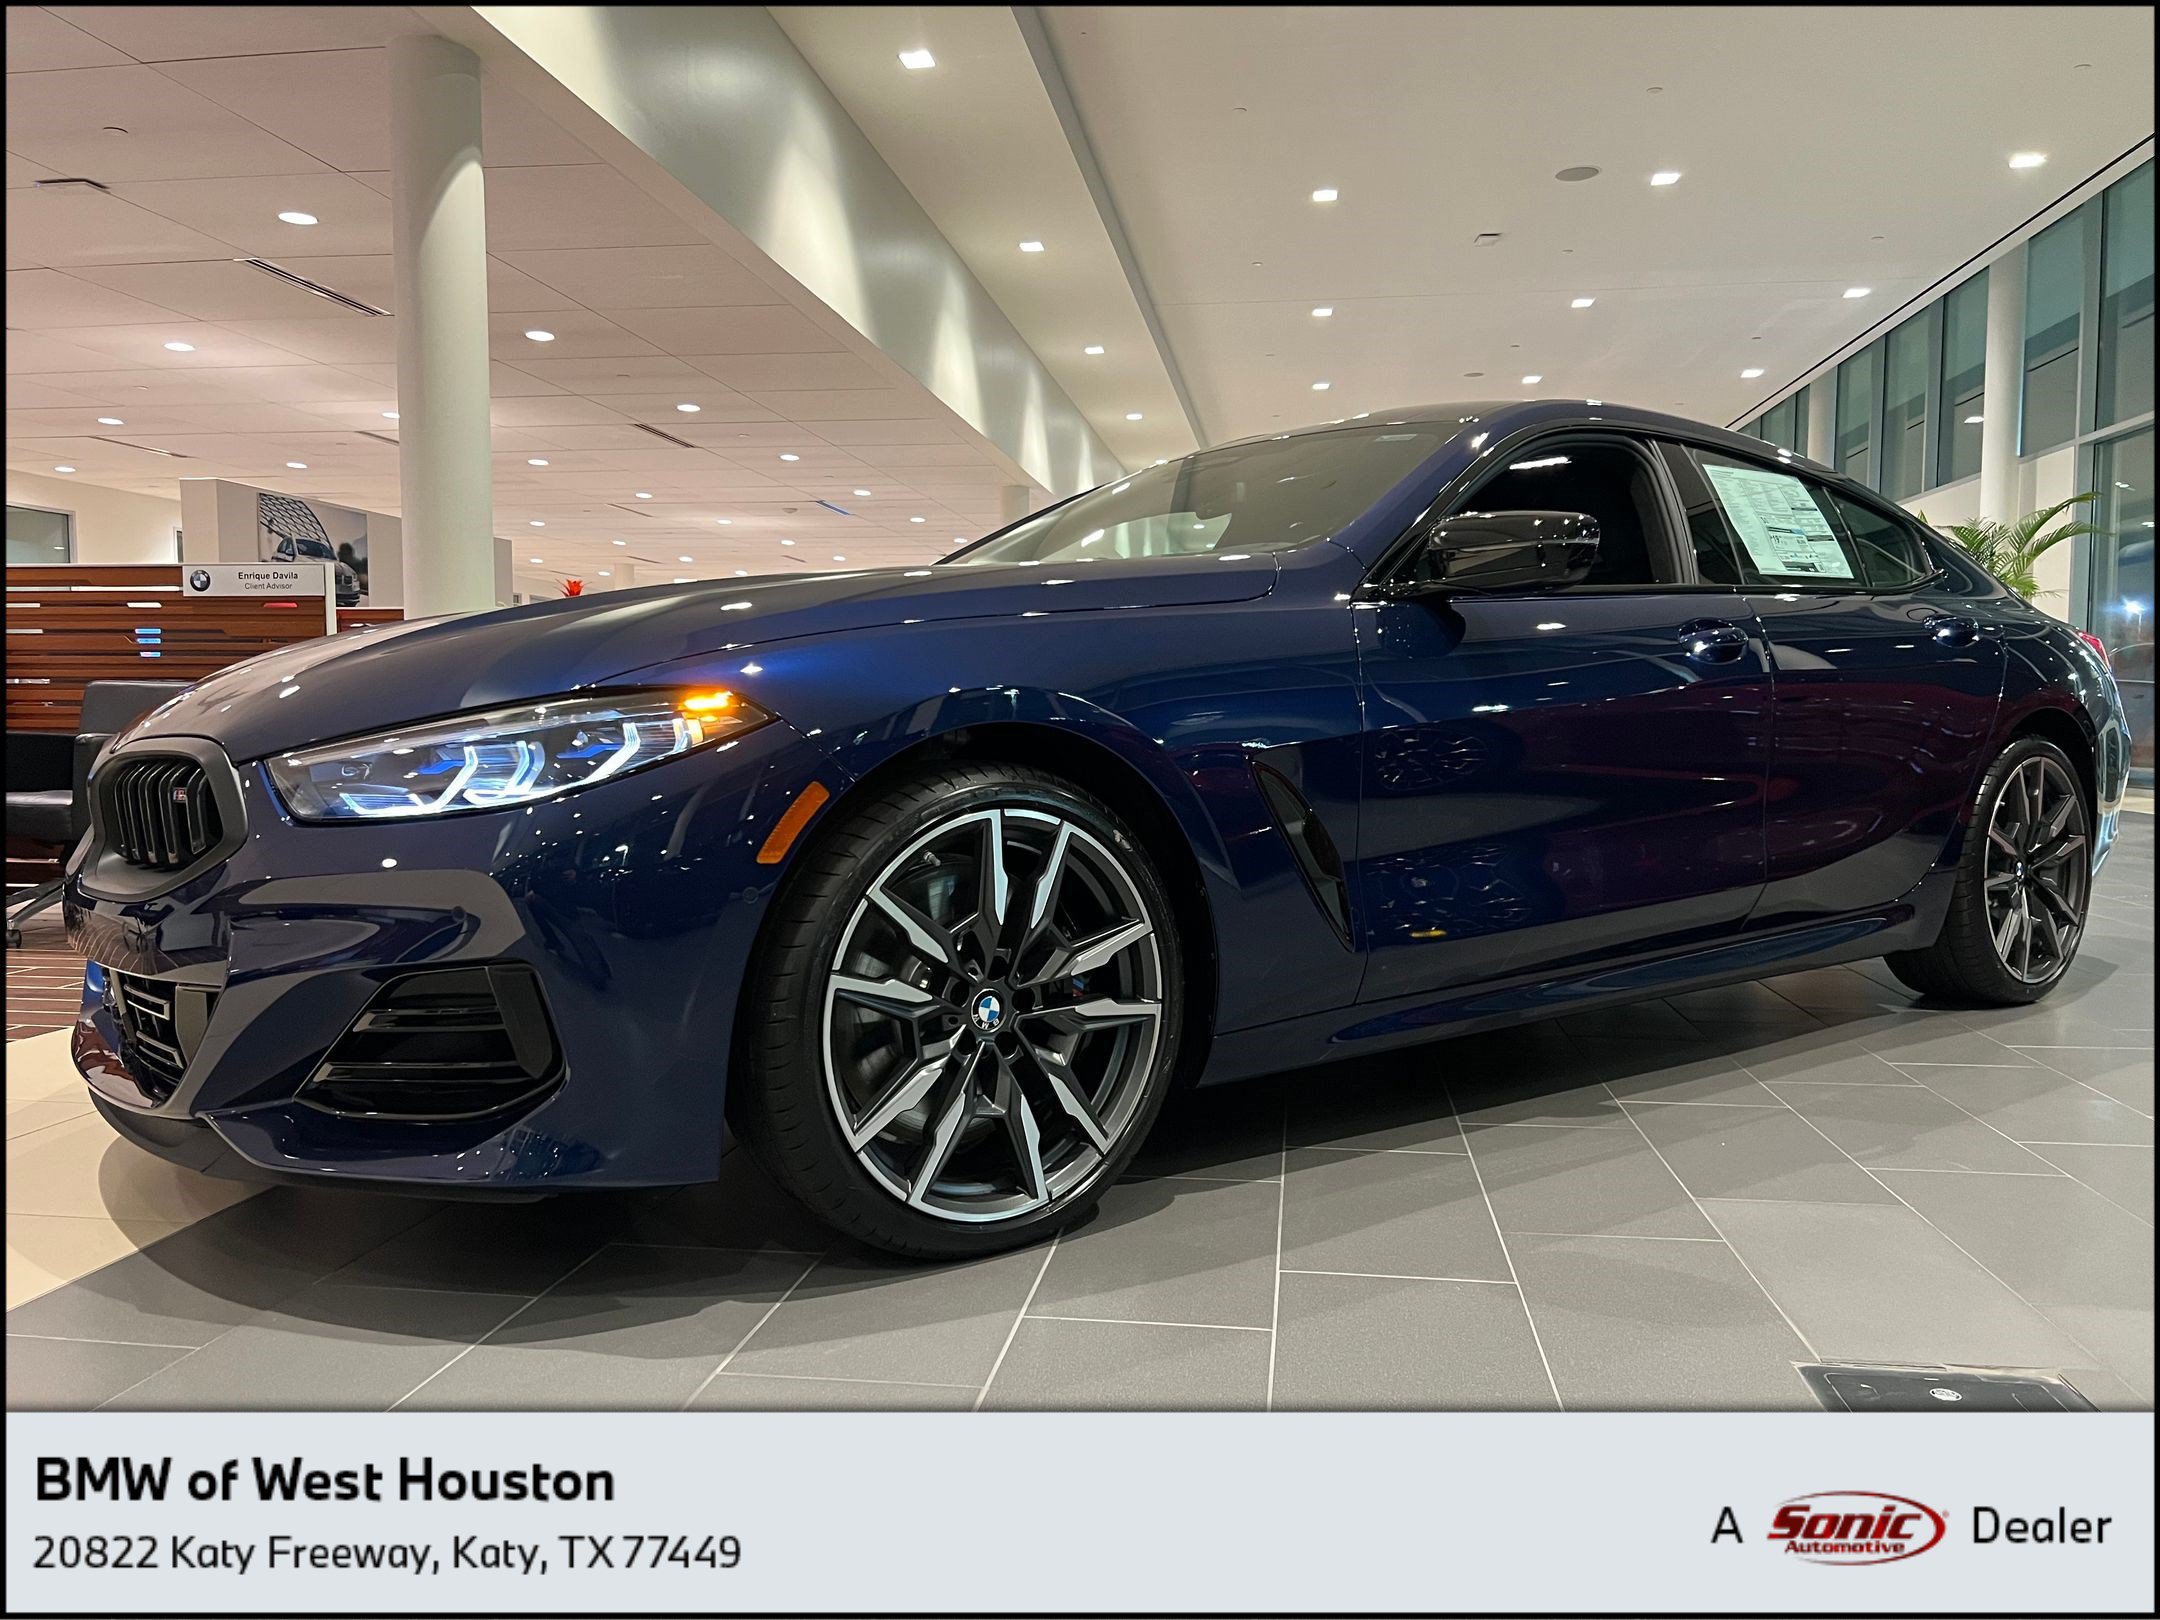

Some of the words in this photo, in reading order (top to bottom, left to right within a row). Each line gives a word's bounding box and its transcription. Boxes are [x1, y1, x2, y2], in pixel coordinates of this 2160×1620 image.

[238, 571, 271, 581] Enrique
[272, 571, 299, 580] Davila
[244, 582, 266, 590] Client
[266, 582, 293, 590] Advisor
